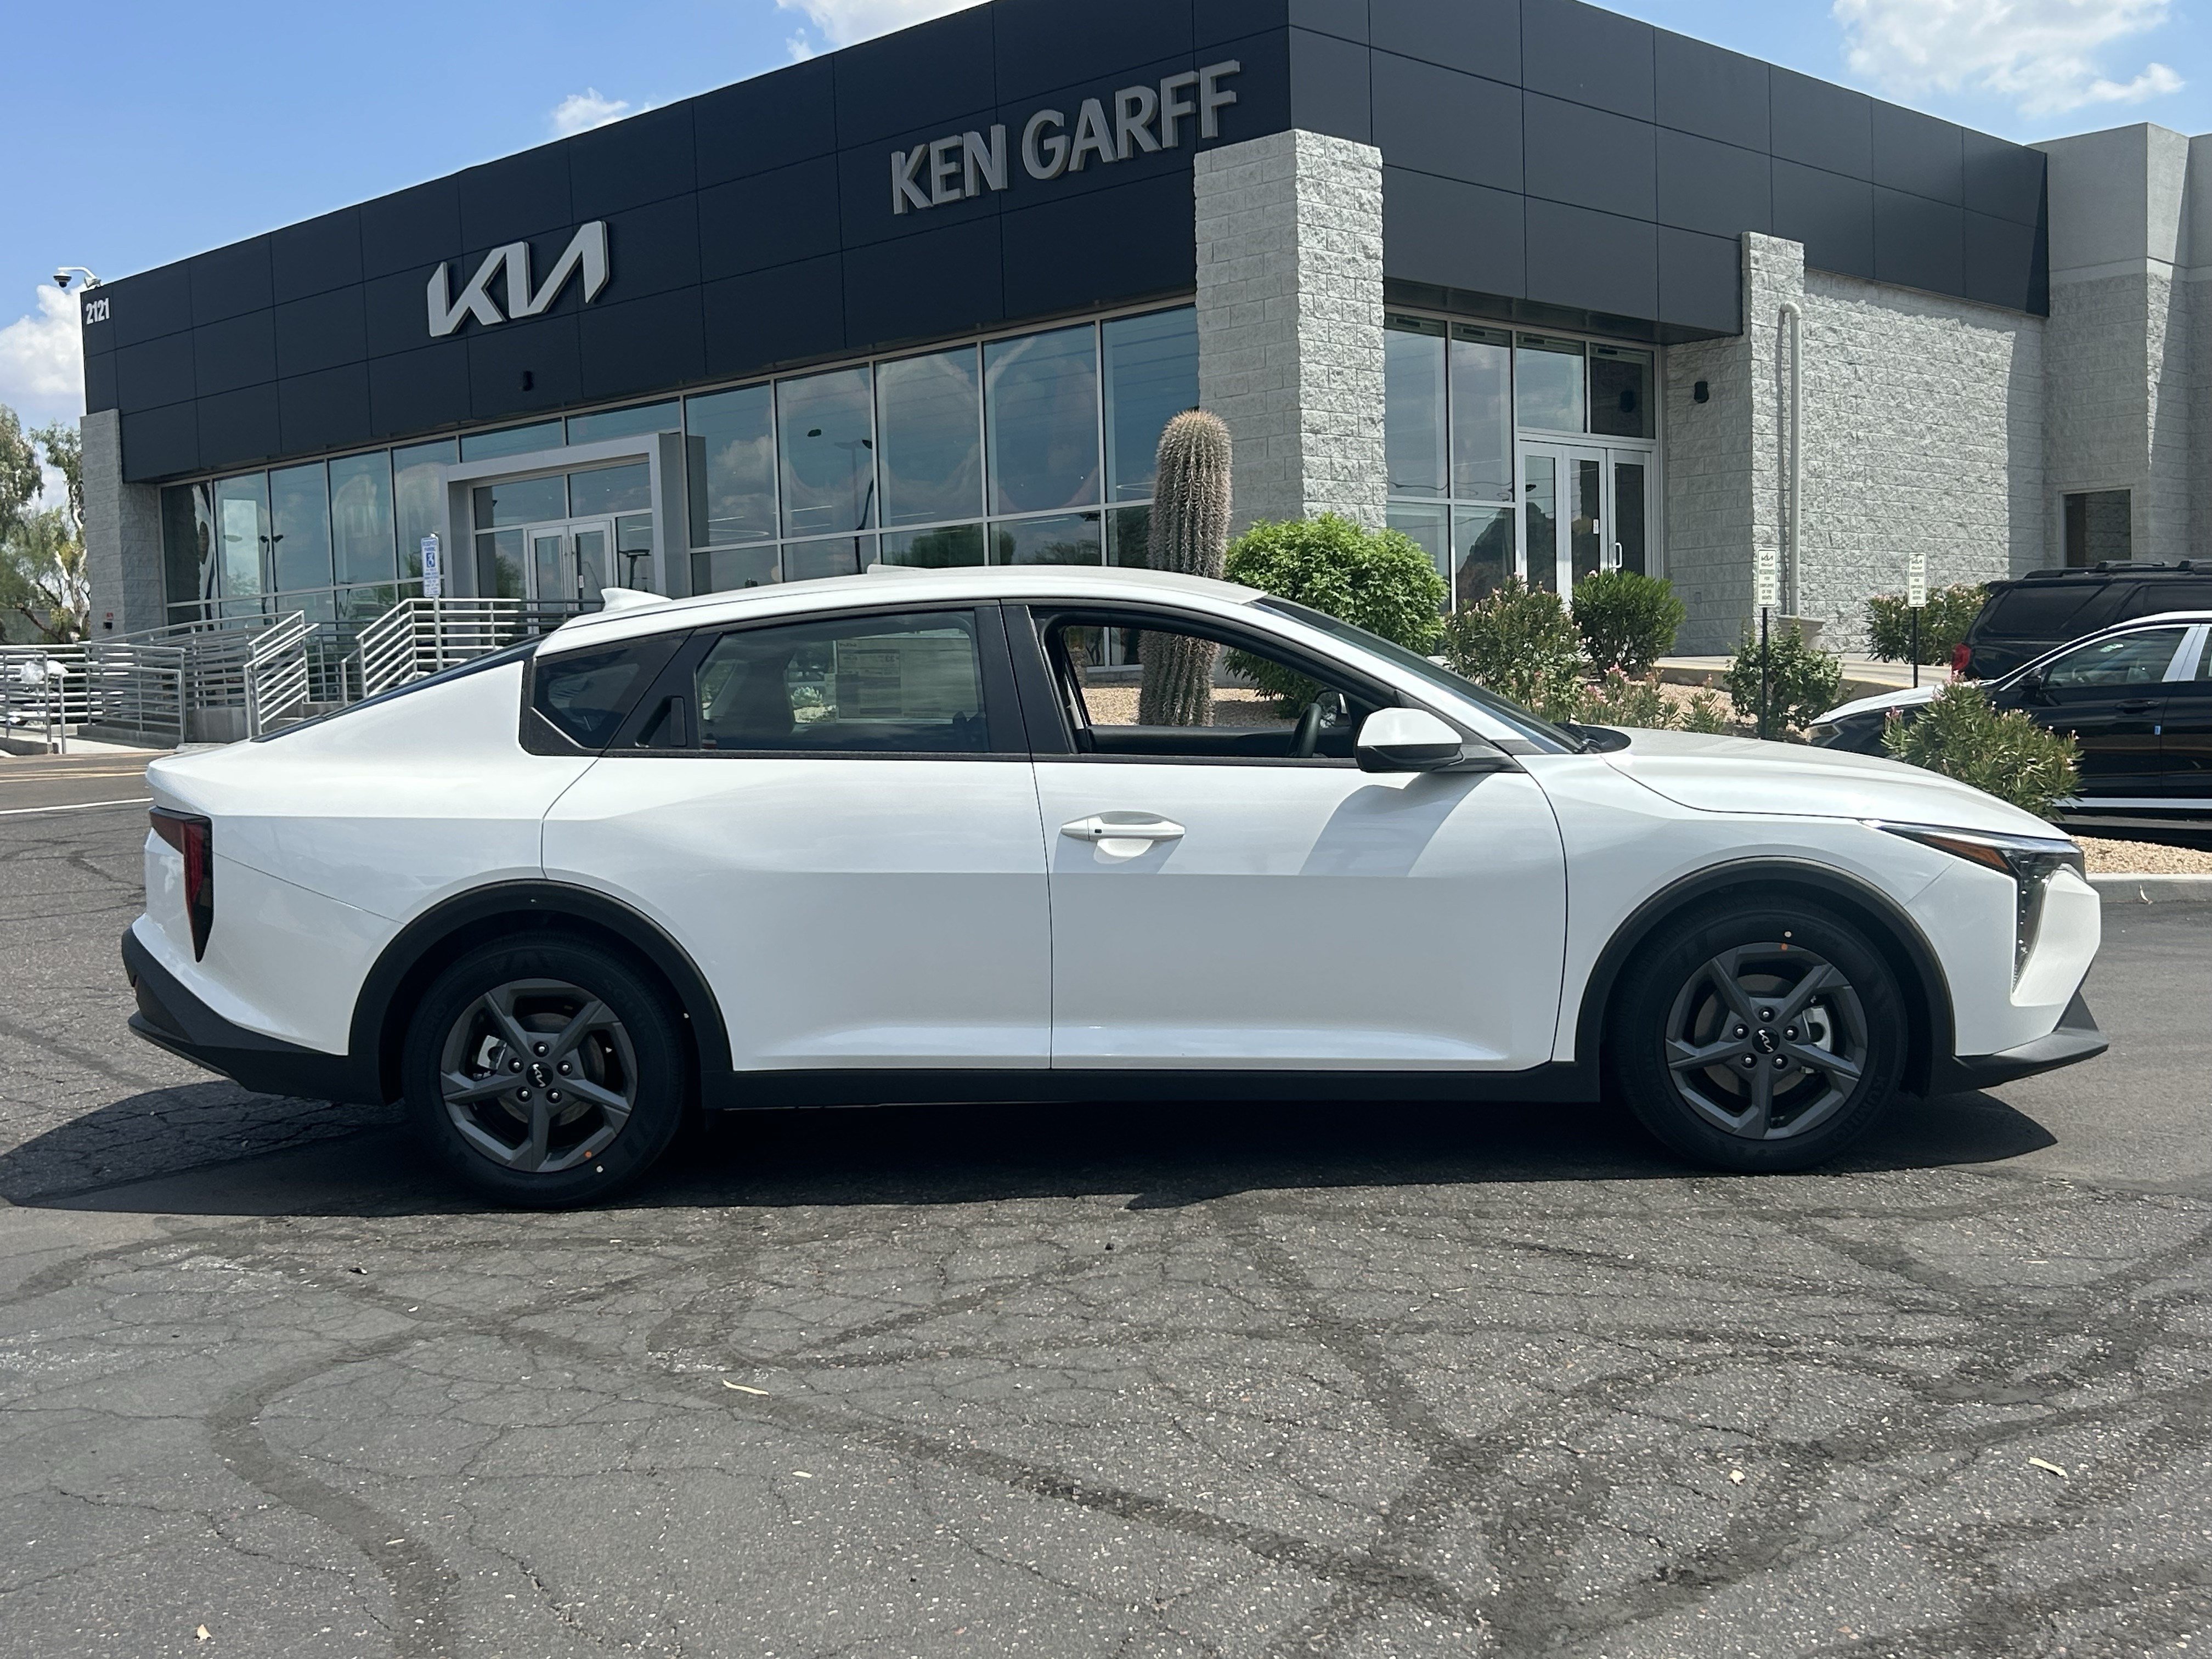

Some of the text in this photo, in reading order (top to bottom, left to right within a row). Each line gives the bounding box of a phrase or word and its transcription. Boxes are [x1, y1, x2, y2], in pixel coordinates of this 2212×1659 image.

[891, 59, 1241, 215] KEN GARFF
[86, 297, 110, 324] 2121
[427, 221, 609, 337] KIA
